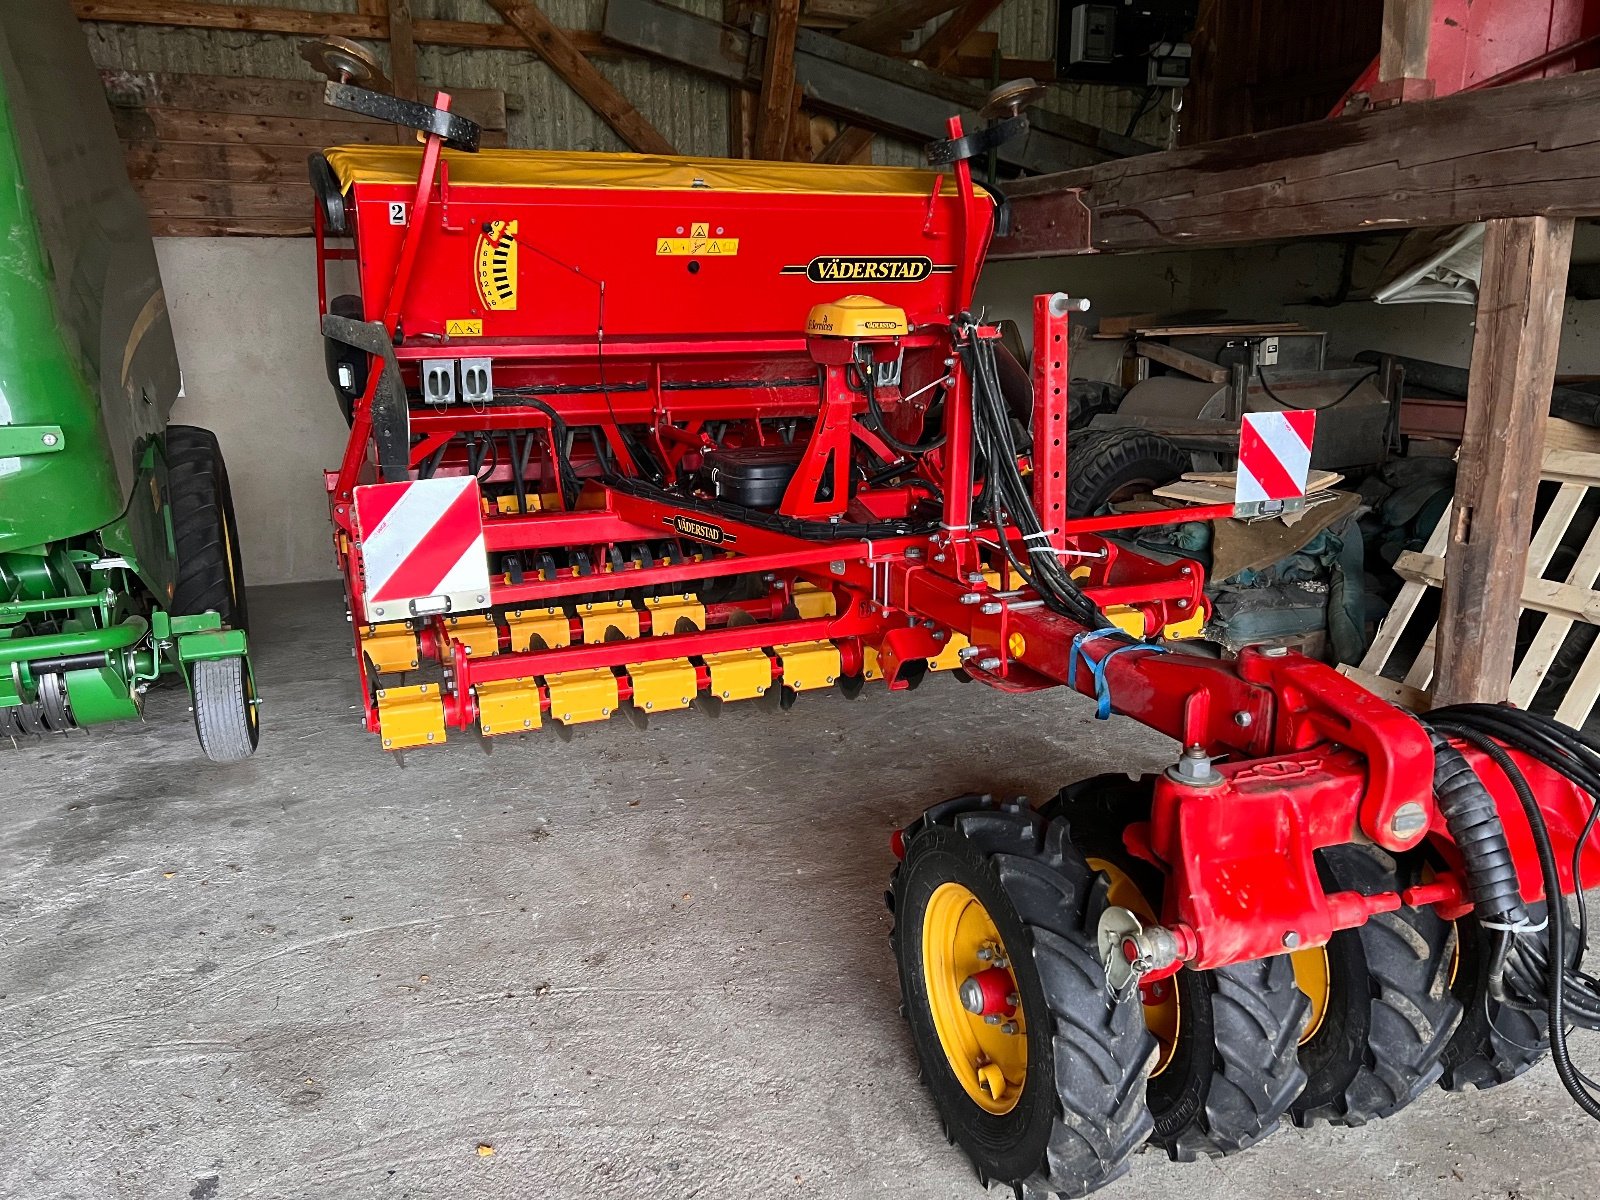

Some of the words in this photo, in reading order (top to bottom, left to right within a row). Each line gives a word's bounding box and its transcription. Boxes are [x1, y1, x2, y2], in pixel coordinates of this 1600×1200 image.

[391, 204, 404, 221] 2
[817, 258, 924, 279] VÄDERSTAD
[677, 518, 720, 540] VÄDERSTAD
